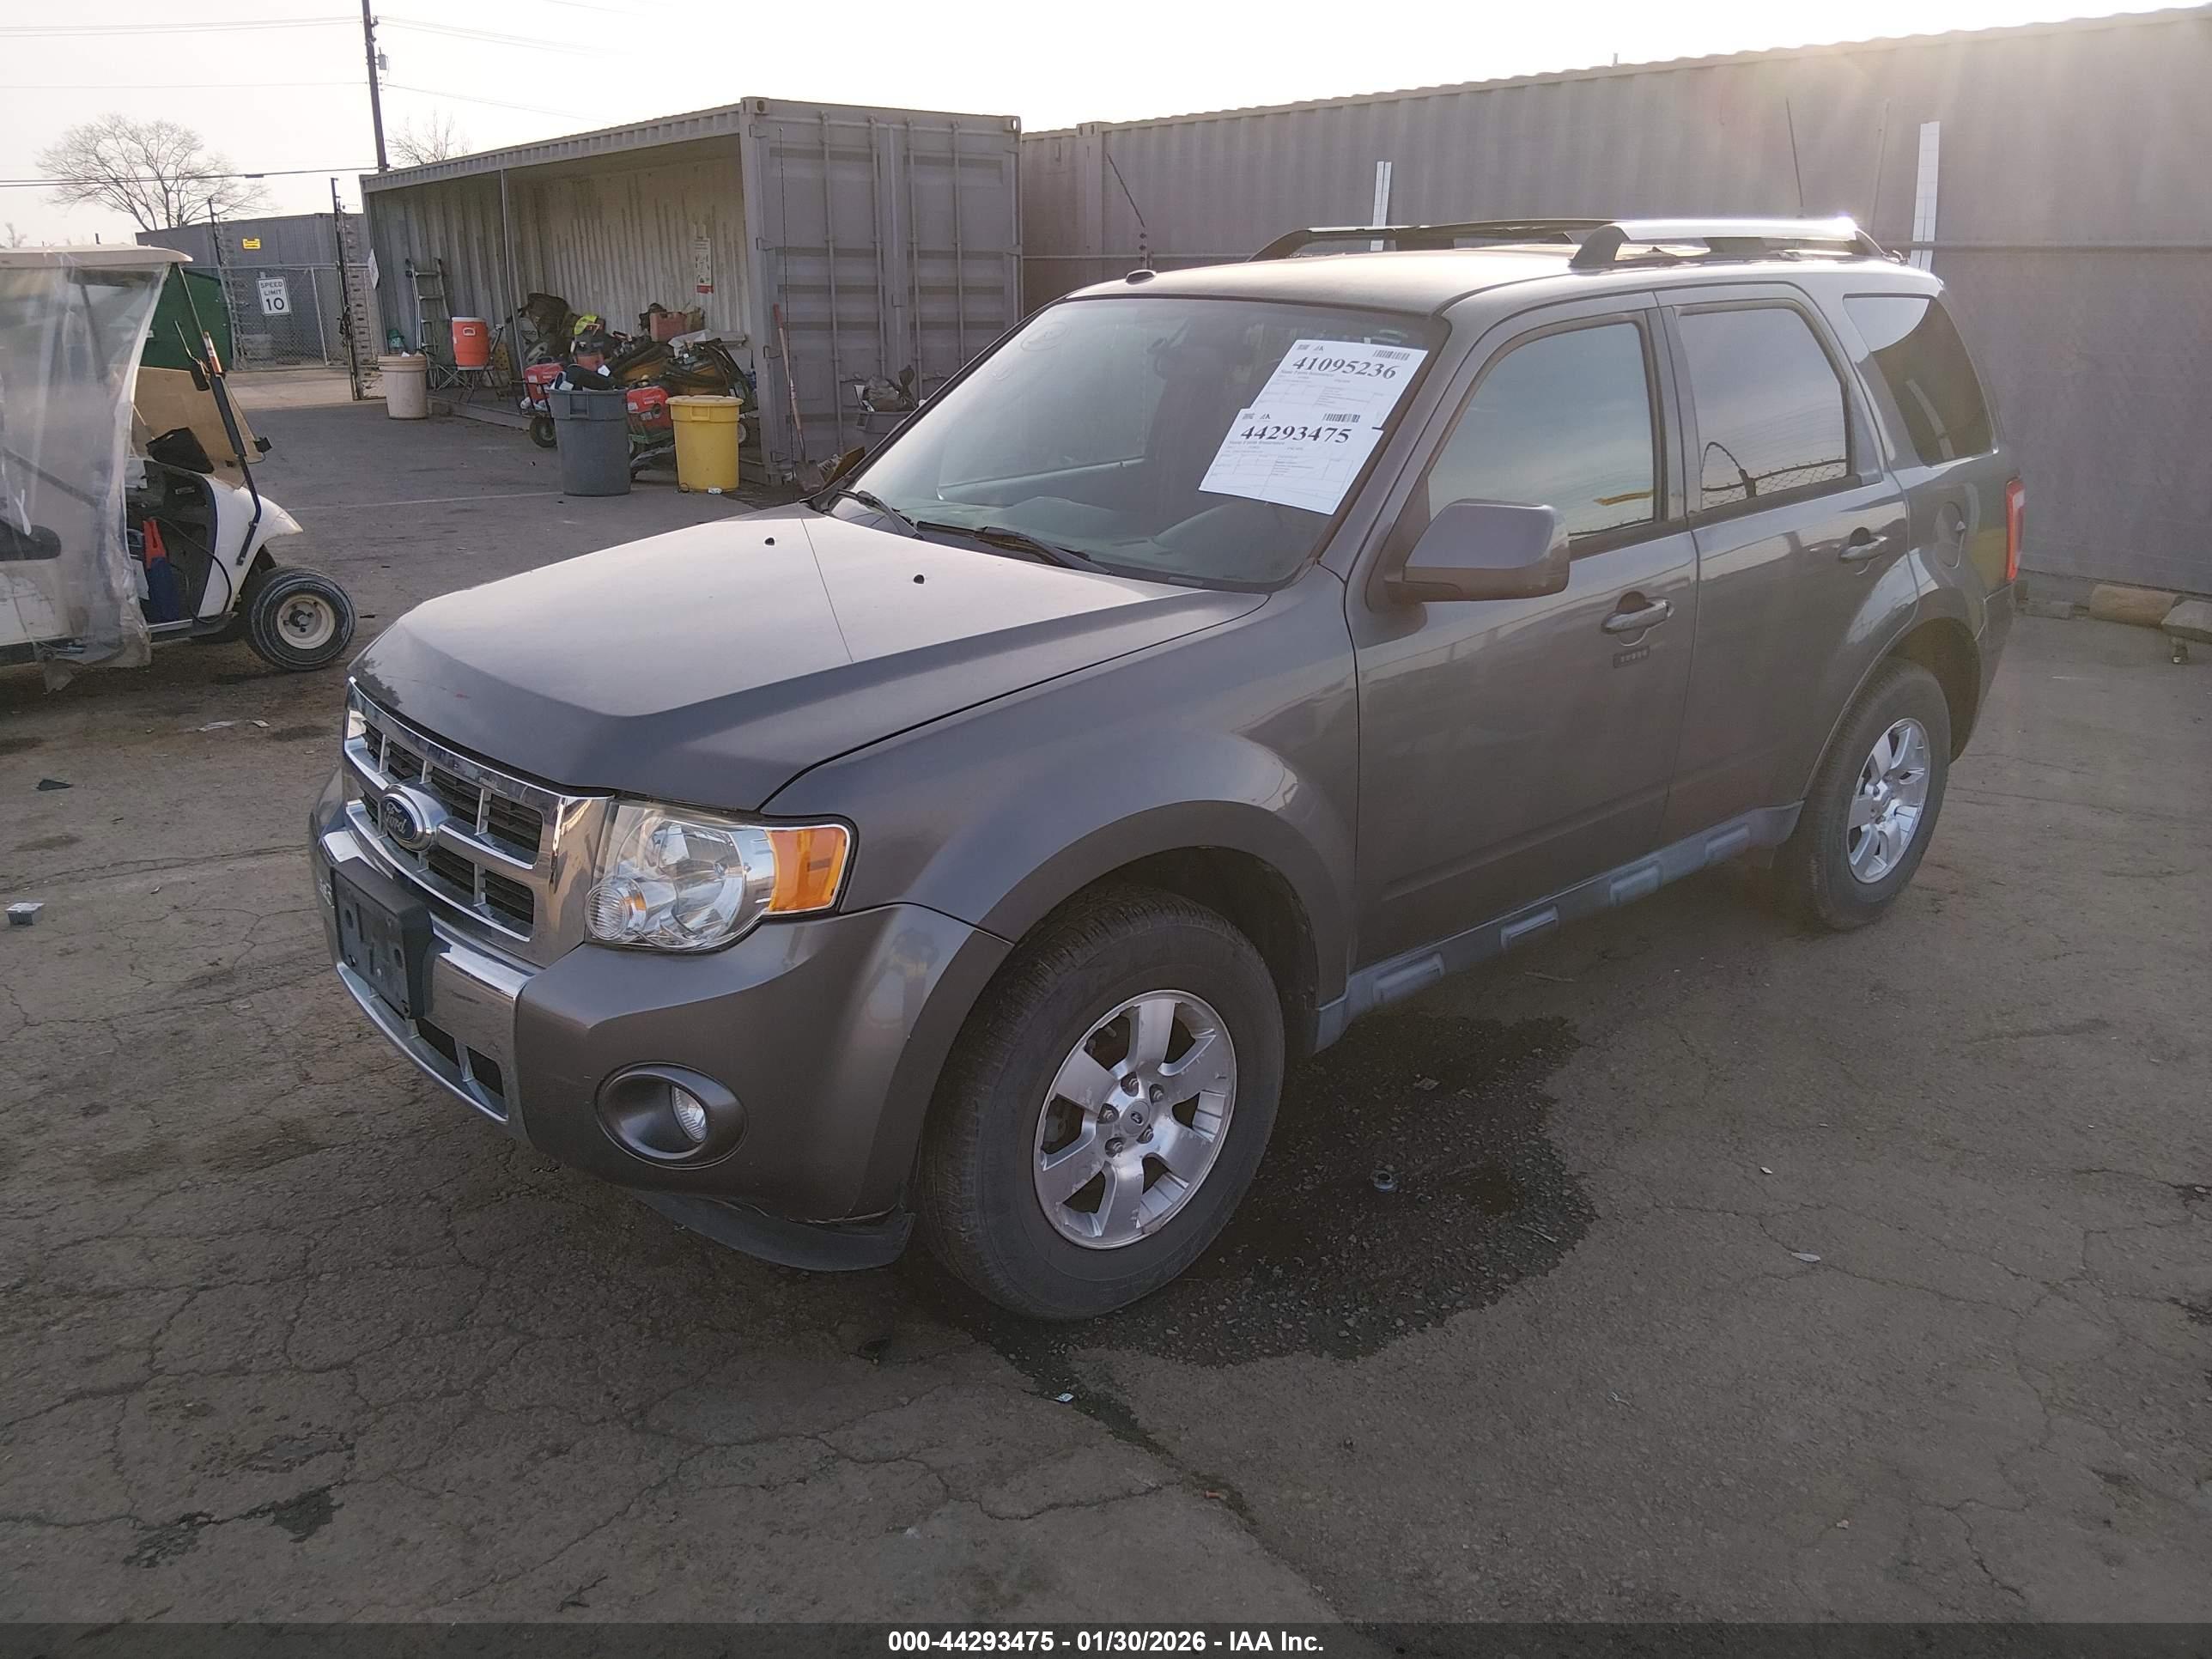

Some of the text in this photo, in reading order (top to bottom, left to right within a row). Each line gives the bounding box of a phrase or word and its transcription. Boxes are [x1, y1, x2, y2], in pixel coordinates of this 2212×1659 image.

[265, 297, 285, 311] 10
[1293, 356, 1401, 380] 41095236
[1241, 426, 1353, 443] 44293475
[384, 801, 408, 834] Ford
